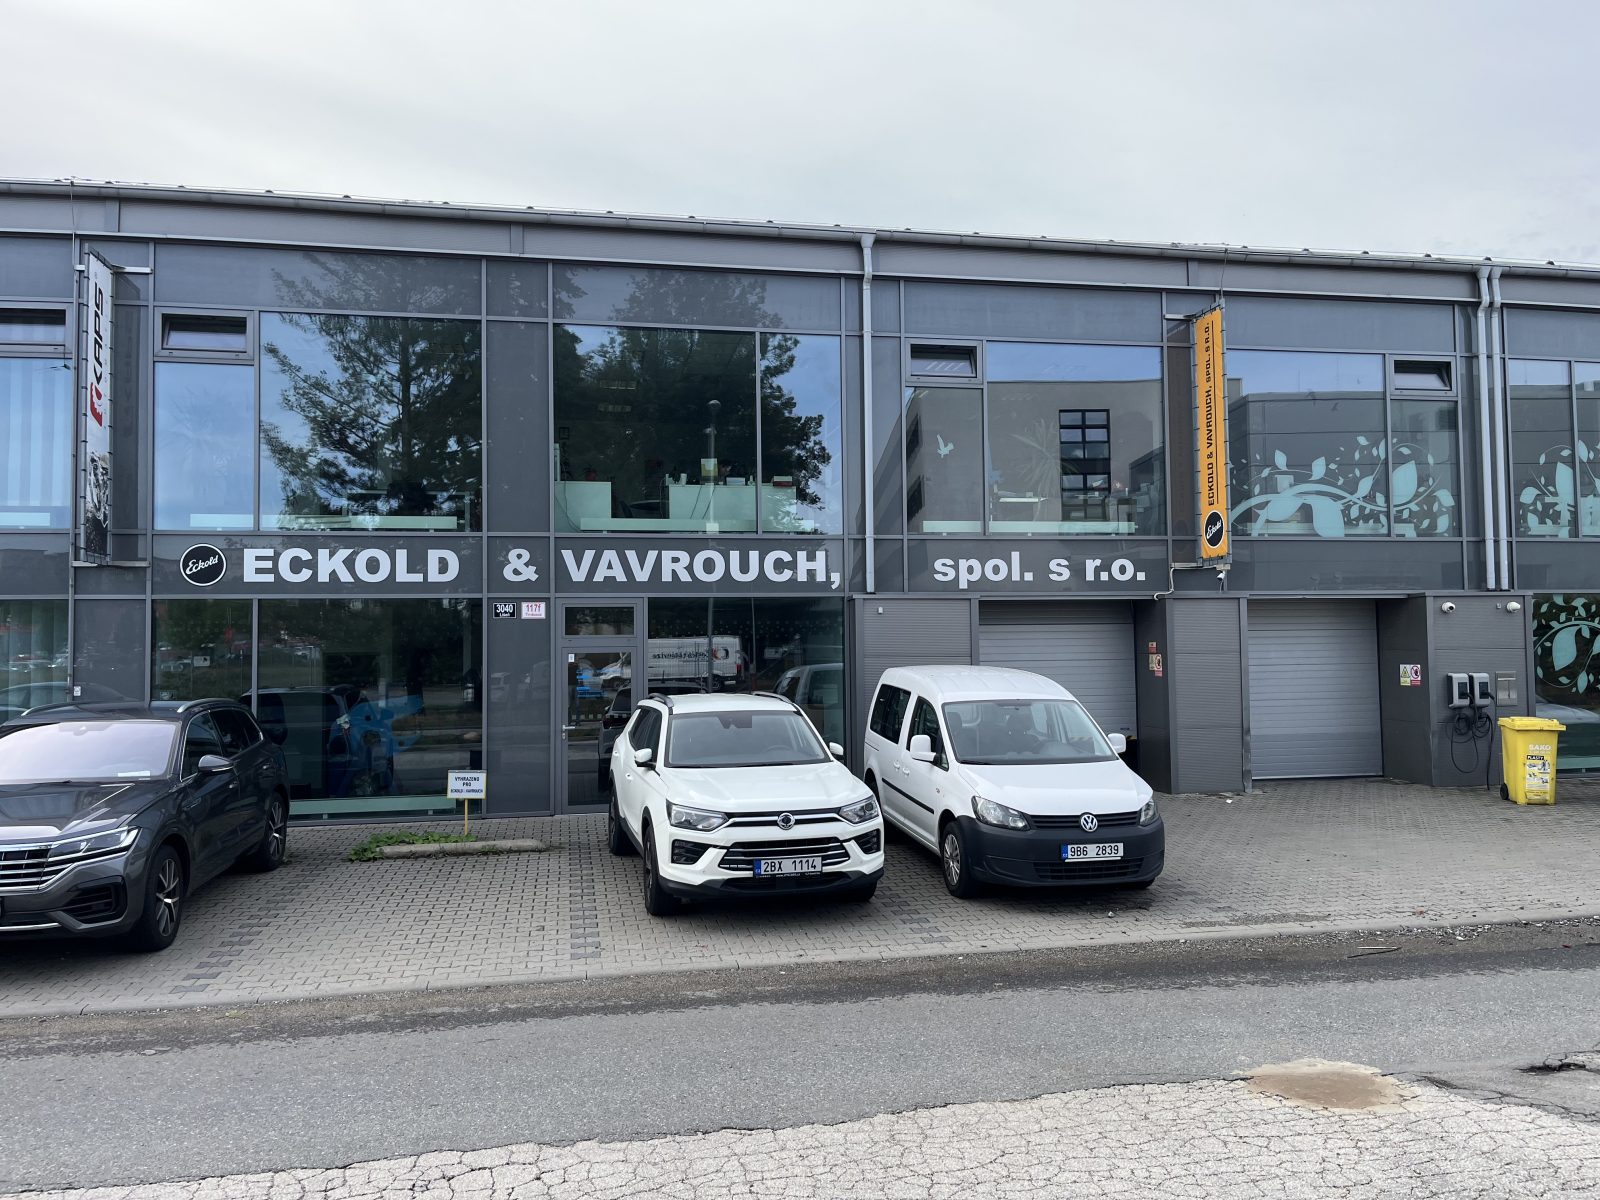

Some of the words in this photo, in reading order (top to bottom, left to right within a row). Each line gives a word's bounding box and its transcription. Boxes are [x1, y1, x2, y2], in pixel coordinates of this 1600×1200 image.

[93, 281, 104, 386] KAPS
[1204, 385, 1214, 449] VAVROUCH,
[1206, 451, 1214, 460] &
[1207, 463, 1215, 507] ECKOLD
[185, 554, 219, 575] Eckold
[243, 547, 460, 583] ECKOLD
[502, 548, 539, 582] &
[561, 549, 841, 590] VAVROUCH,
[933, 551, 1034, 590] spol.
[1048, 558, 1071, 582] s
[1085, 558, 1146, 582] r.o.
[496, 604, 514, 613] 3040
[1070, 846, 1088, 857] 9B6
[1095, 844, 1119, 856] 2839
[763, 861, 783, 873] 2BX
[791, 859, 817, 871] 1114
